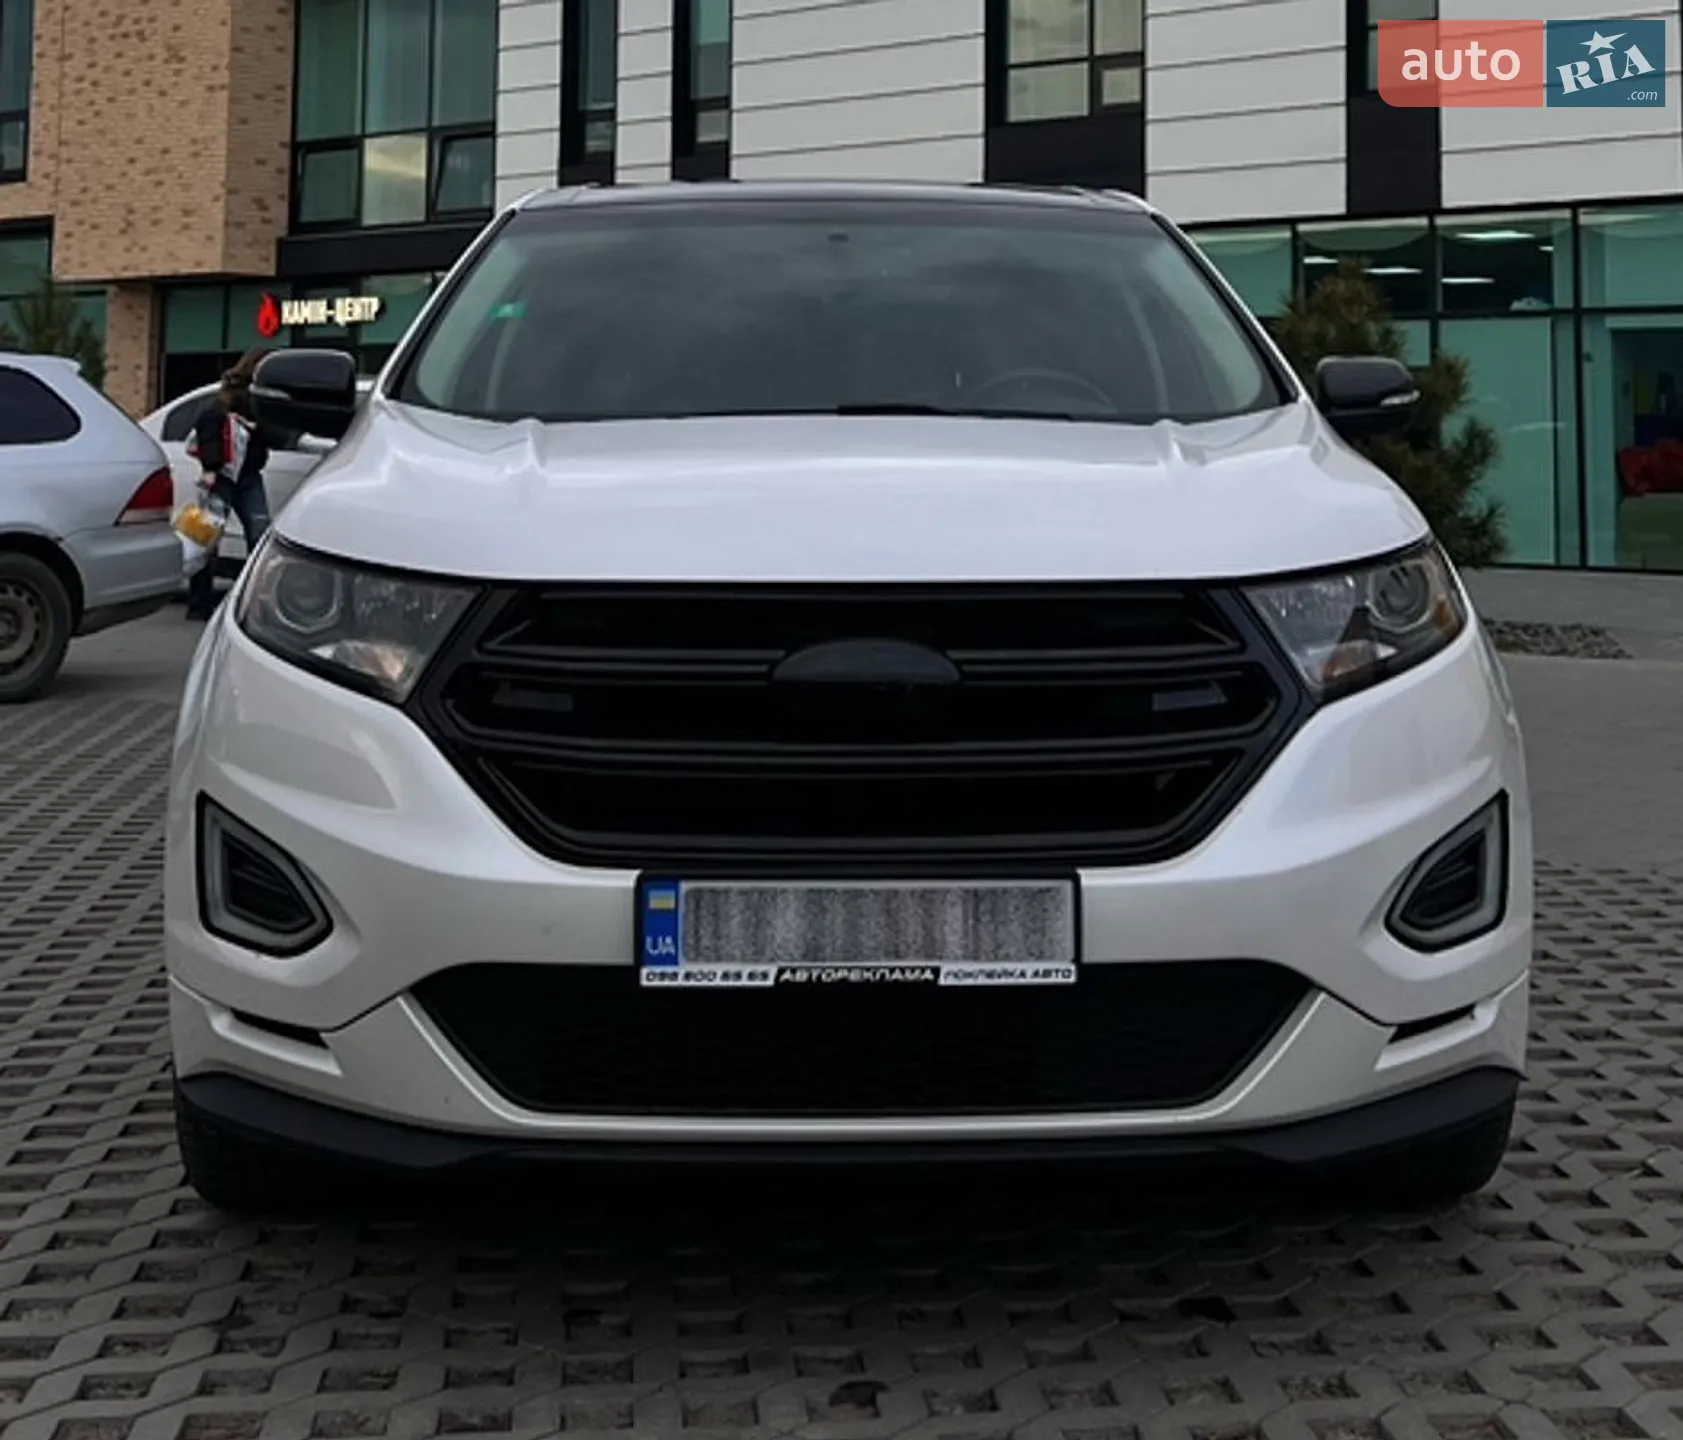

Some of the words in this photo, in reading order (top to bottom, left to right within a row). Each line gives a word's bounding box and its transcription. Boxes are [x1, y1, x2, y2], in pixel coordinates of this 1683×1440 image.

[645, 935, 676, 957] UA
[778, 967, 935, 983] АВТОРЕКЛАМА
[1030, 968, 1073, 980] АВТО
